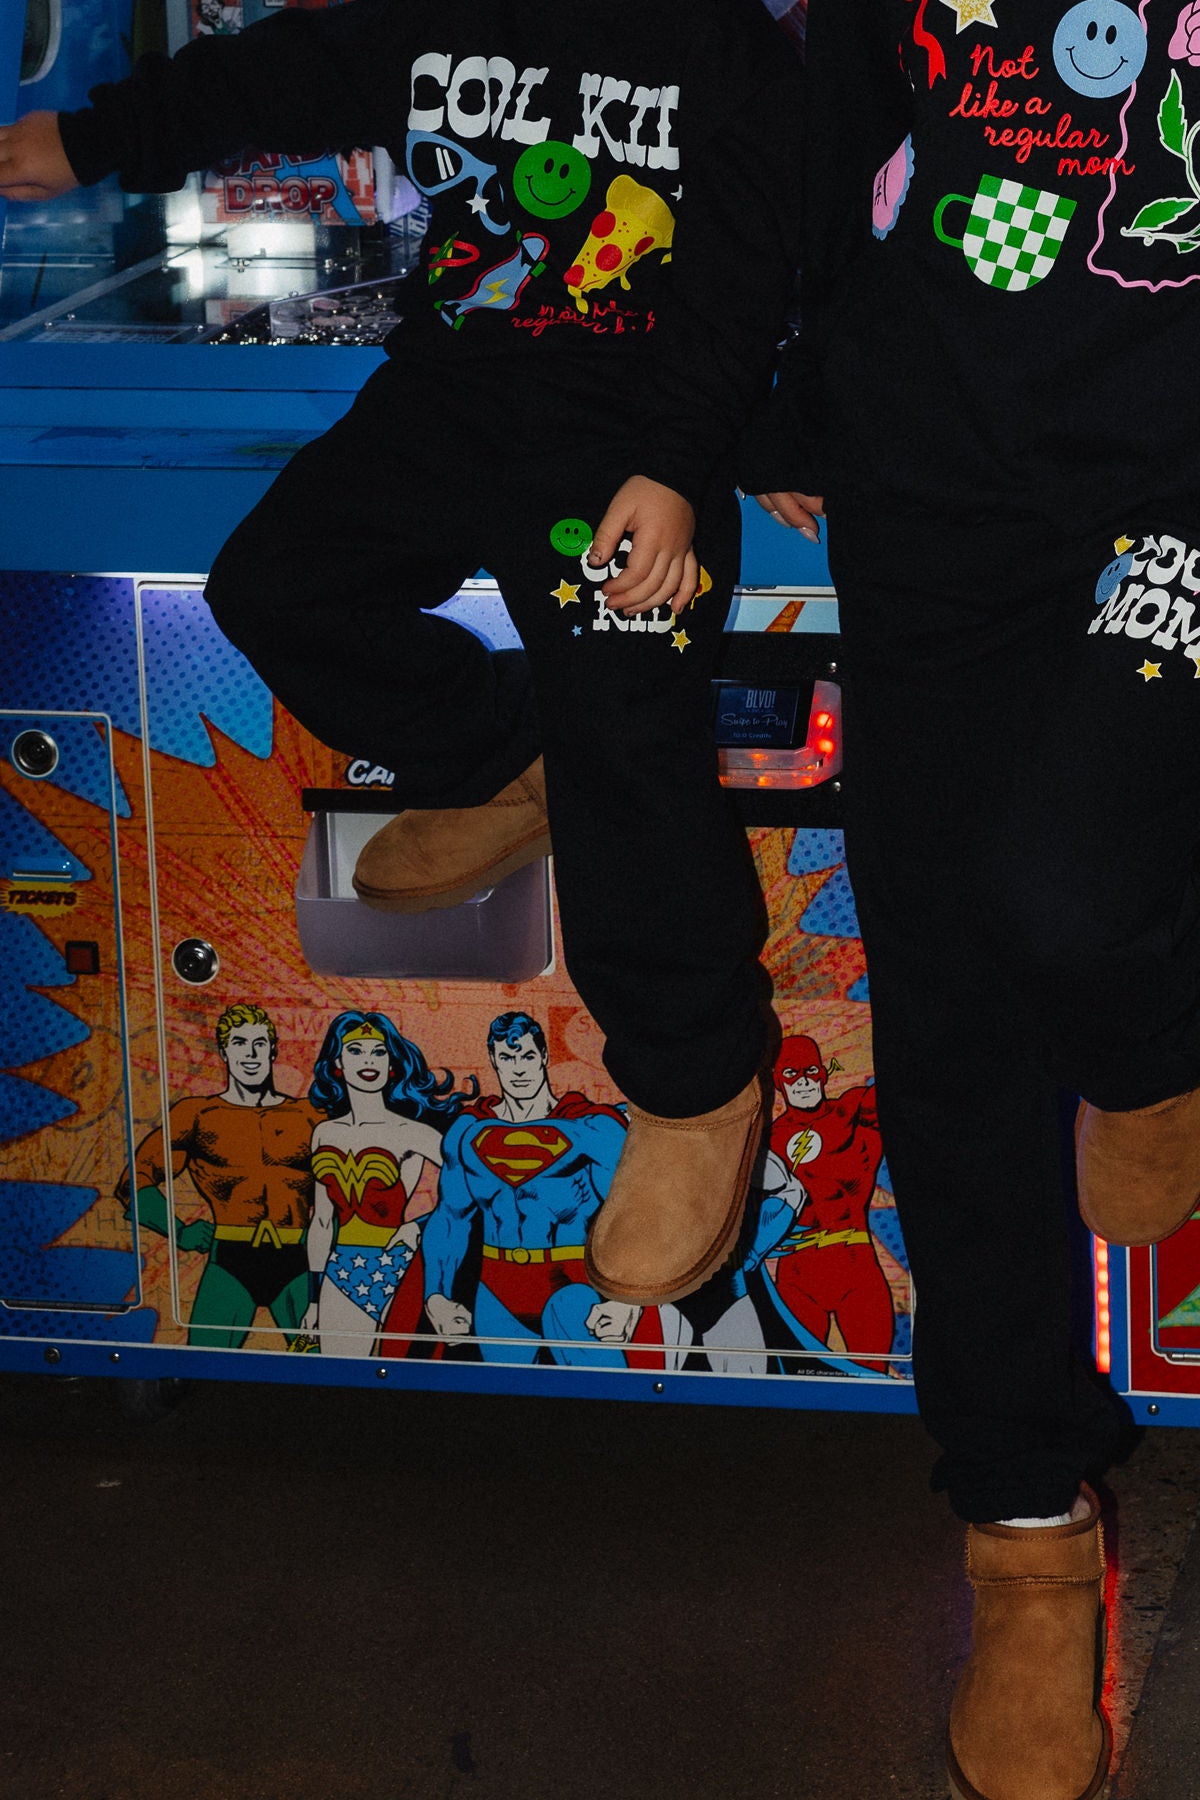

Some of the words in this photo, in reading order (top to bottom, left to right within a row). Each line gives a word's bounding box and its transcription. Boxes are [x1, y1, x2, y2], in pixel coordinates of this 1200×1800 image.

[969, 44, 1040, 80] Not
[407, 51, 552, 146] COOL
[948, 81, 1020, 119] like
[1025, 96, 1053, 116] a
[983, 115, 1111, 164] regular
[1056, 156, 1136, 178] mom
[223, 175, 338, 215] DROP
